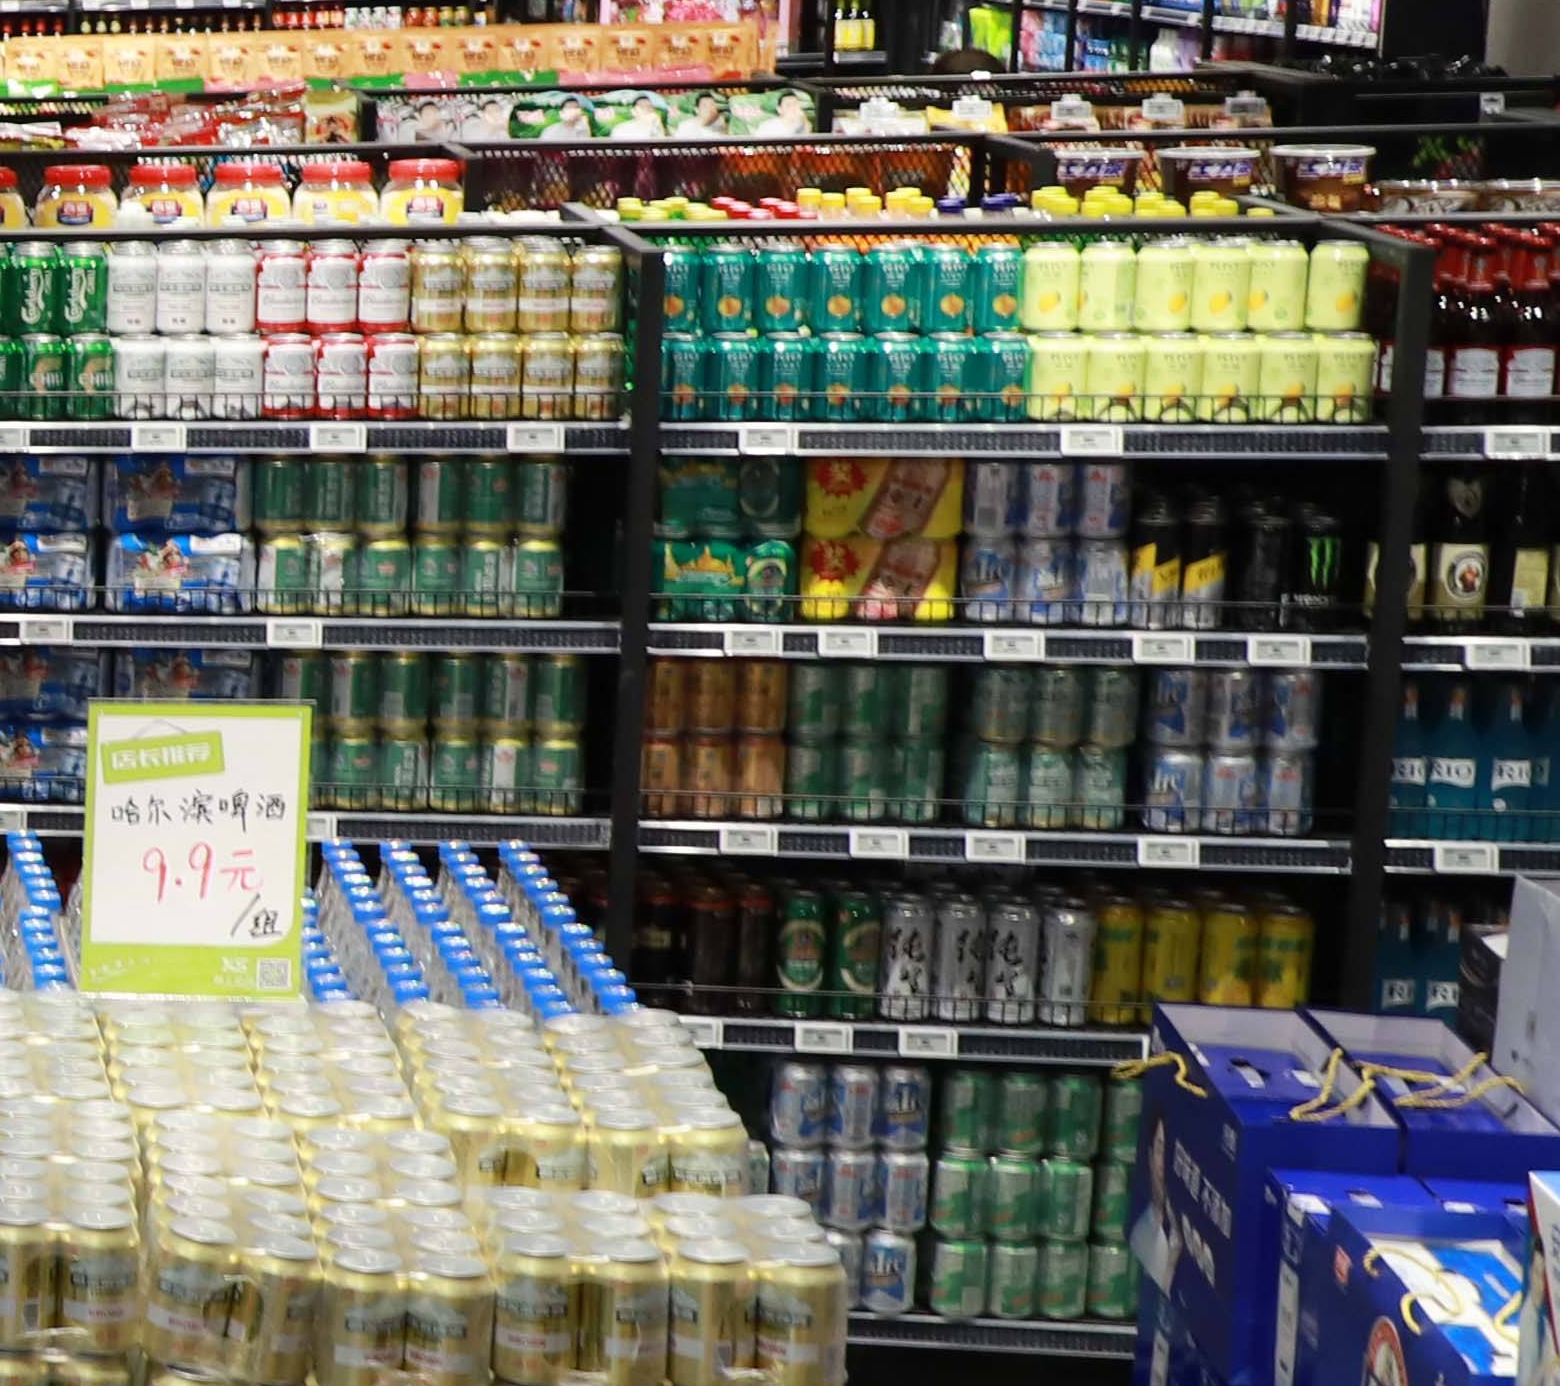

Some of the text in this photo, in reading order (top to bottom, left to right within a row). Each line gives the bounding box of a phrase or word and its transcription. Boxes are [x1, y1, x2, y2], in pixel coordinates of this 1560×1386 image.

[112, 742, 212, 771] 店长推荐
[111, 788, 286, 832] 哈尔滨啤酒
